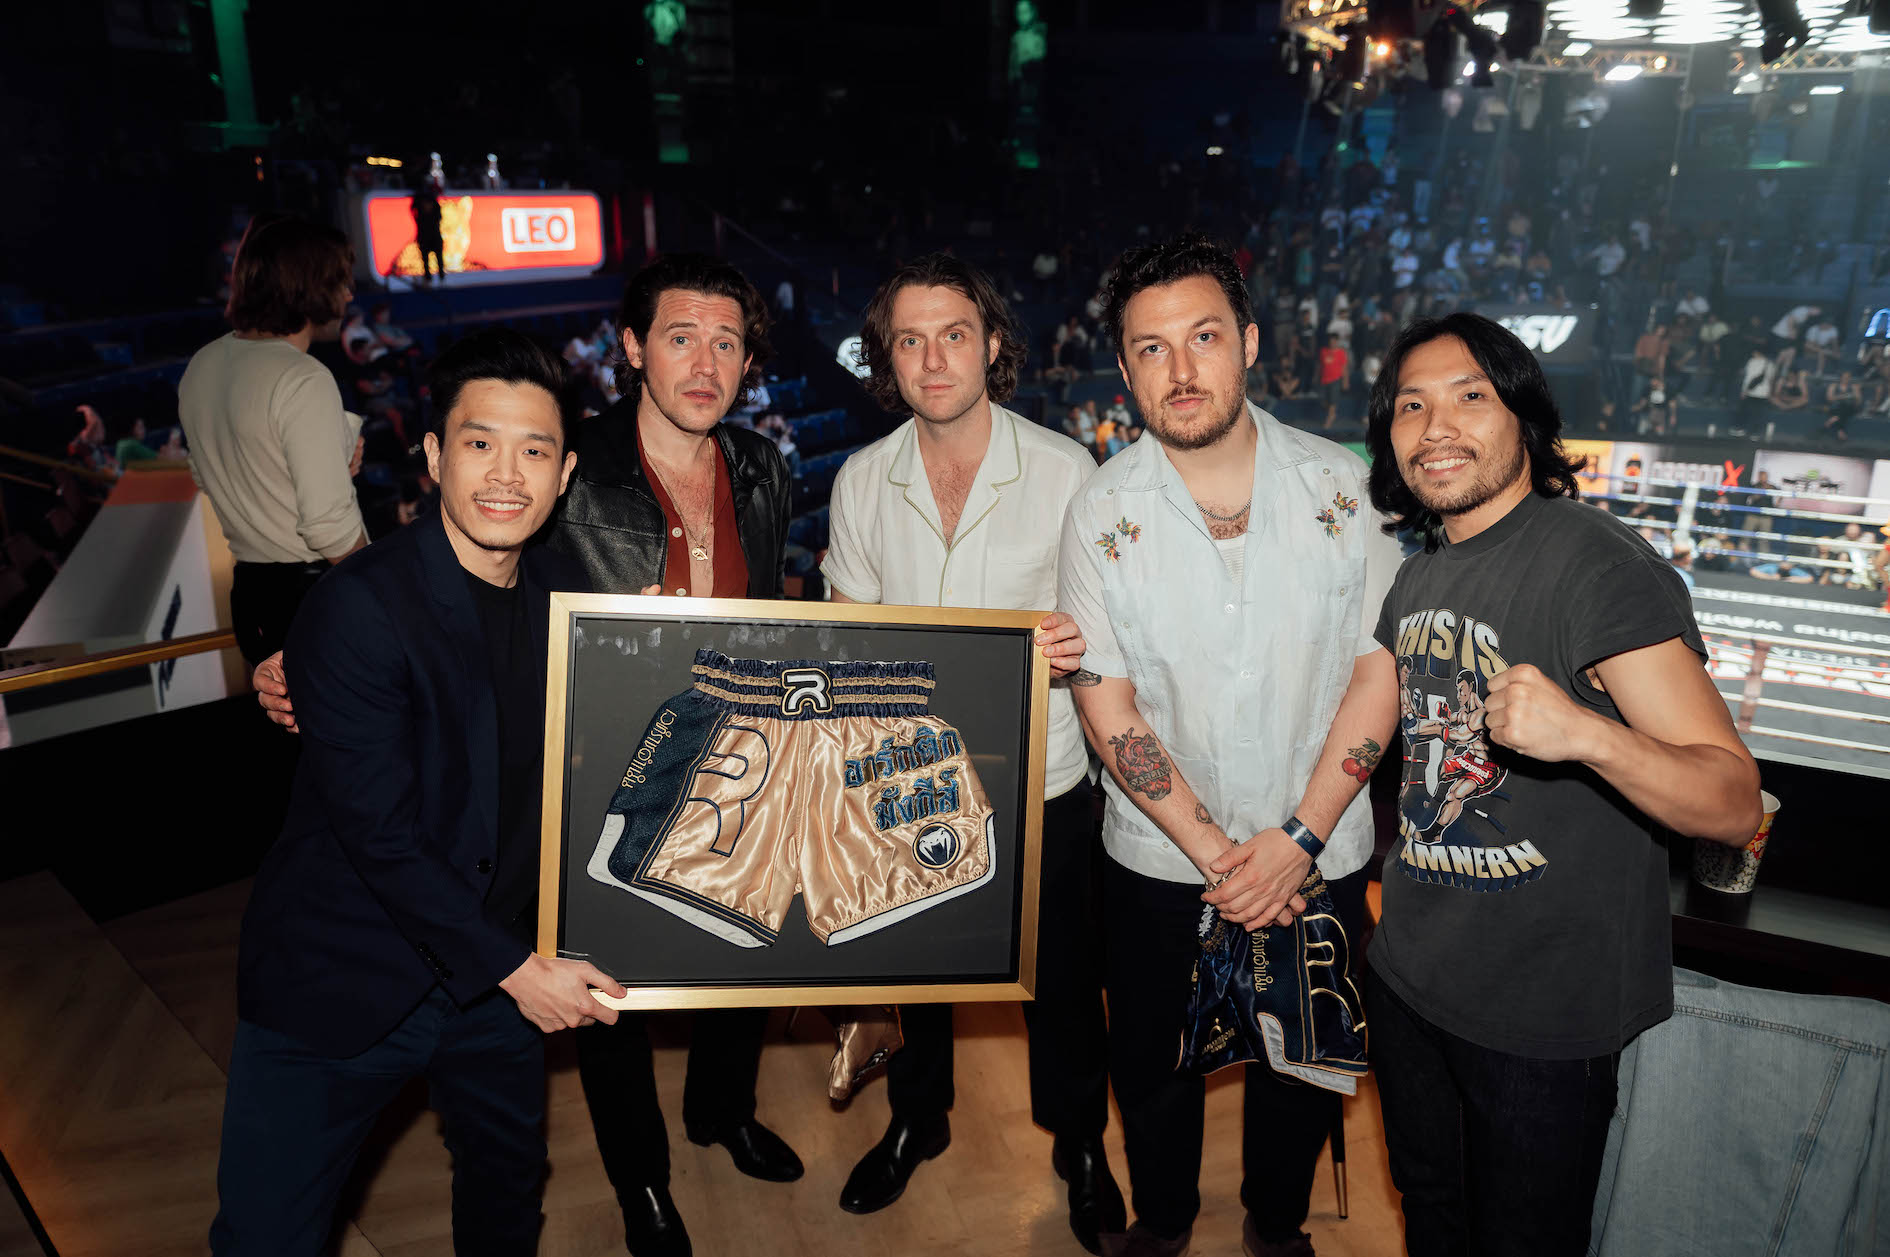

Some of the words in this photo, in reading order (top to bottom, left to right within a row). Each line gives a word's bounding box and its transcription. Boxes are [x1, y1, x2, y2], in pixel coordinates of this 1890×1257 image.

[509, 214, 569, 245] LEO
[1396, 609, 1456, 668] THIS
[1457, 616, 1511, 682] IS
[844, 726, 961, 788] อาร์กติก
[873, 765, 960, 831] มังกีส์
[1399, 836, 1548, 888] AMNERN
[1252, 929, 1274, 993] ทีราชดำเนิน
